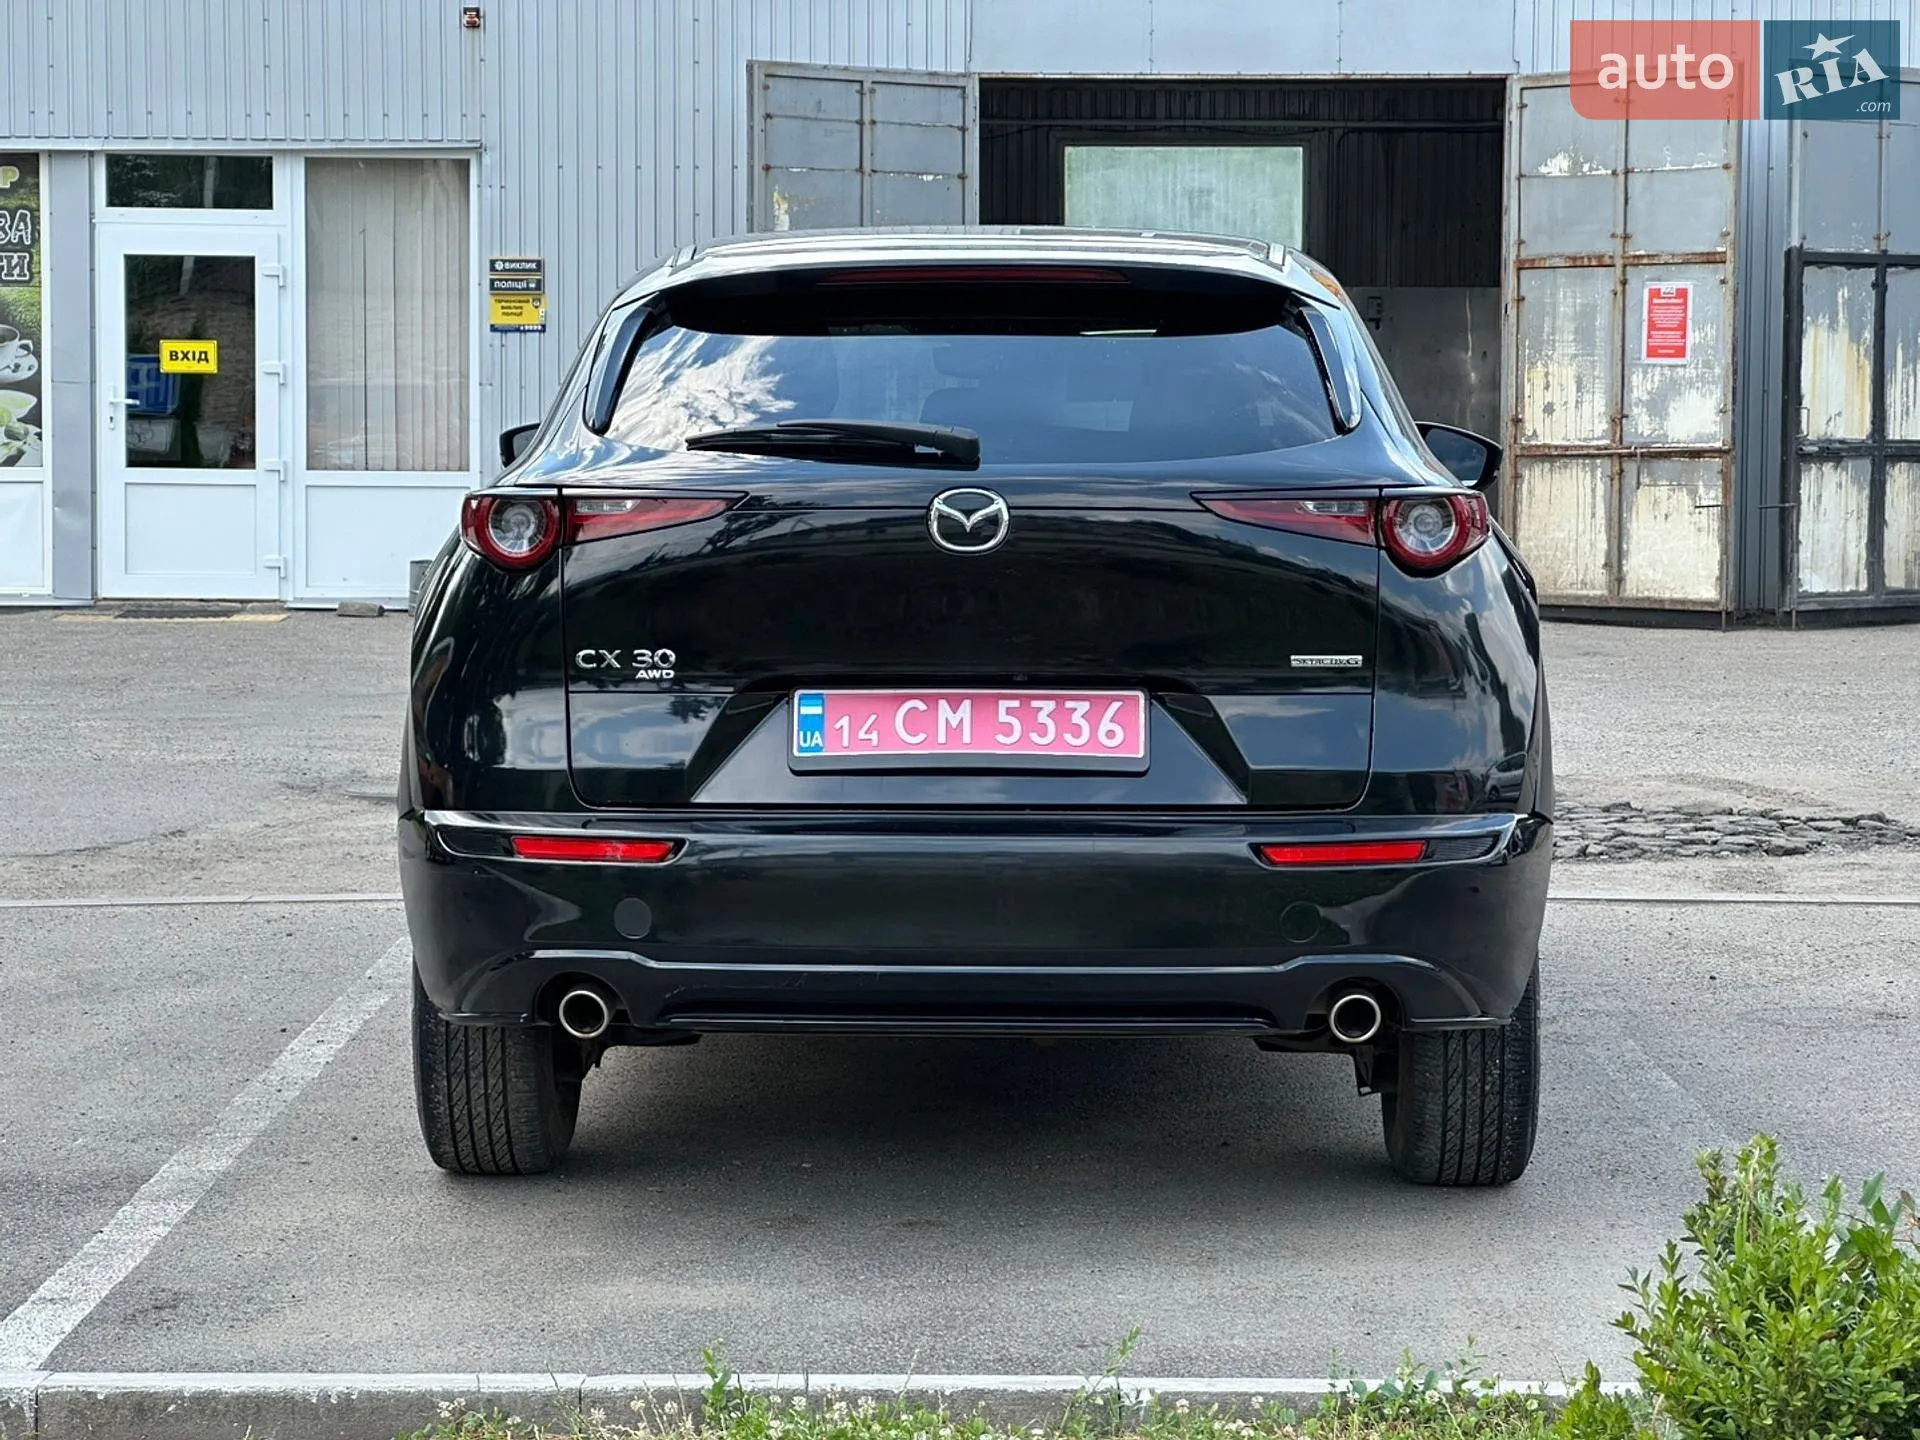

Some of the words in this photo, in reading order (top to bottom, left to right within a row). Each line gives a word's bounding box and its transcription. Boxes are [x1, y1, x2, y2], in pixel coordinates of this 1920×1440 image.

[169, 350, 209, 363] ВХІД
[575, 649, 622, 669] CX
[631, 648, 676, 669] 30
[635, 669, 675, 679] AWD
[834, 714, 879, 748] 14
[894, 699, 973, 745] CM
[993, 699, 1125, 748] 5336
[800, 731, 824, 748] UA
